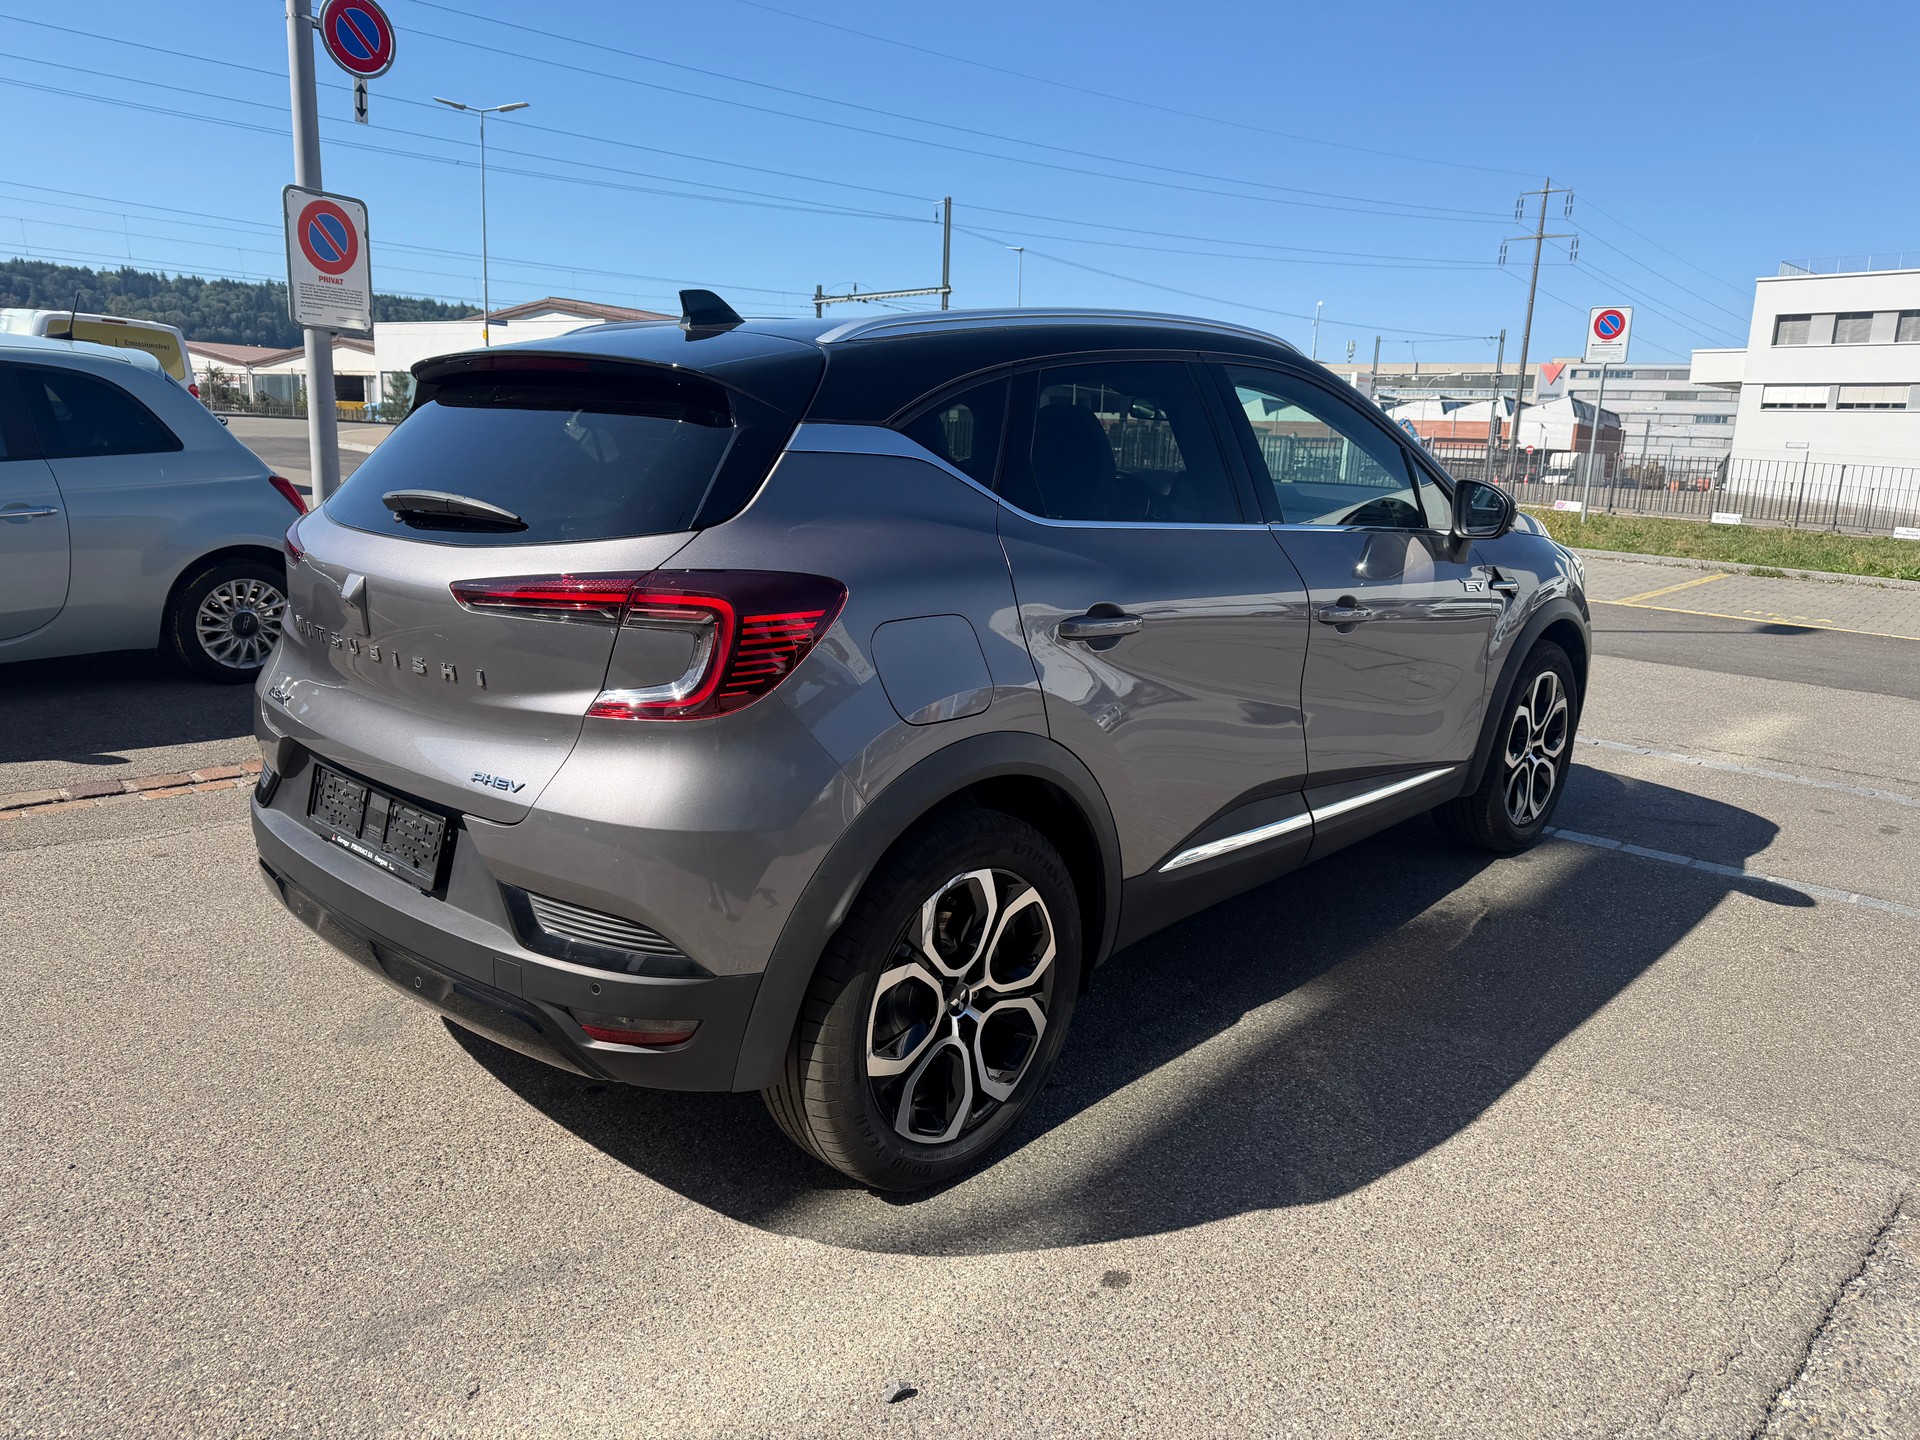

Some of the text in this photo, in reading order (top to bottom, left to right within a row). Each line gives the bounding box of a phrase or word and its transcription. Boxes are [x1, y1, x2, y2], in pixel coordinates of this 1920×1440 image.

[318, 275, 344, 285] PRIVAT
[123, 339, 170, 350] Emissionsfrei
[1465, 582, 1485, 592] EV
[296, 614, 485, 687] MITSUBISHI
[471, 770, 526, 793] PHEV
